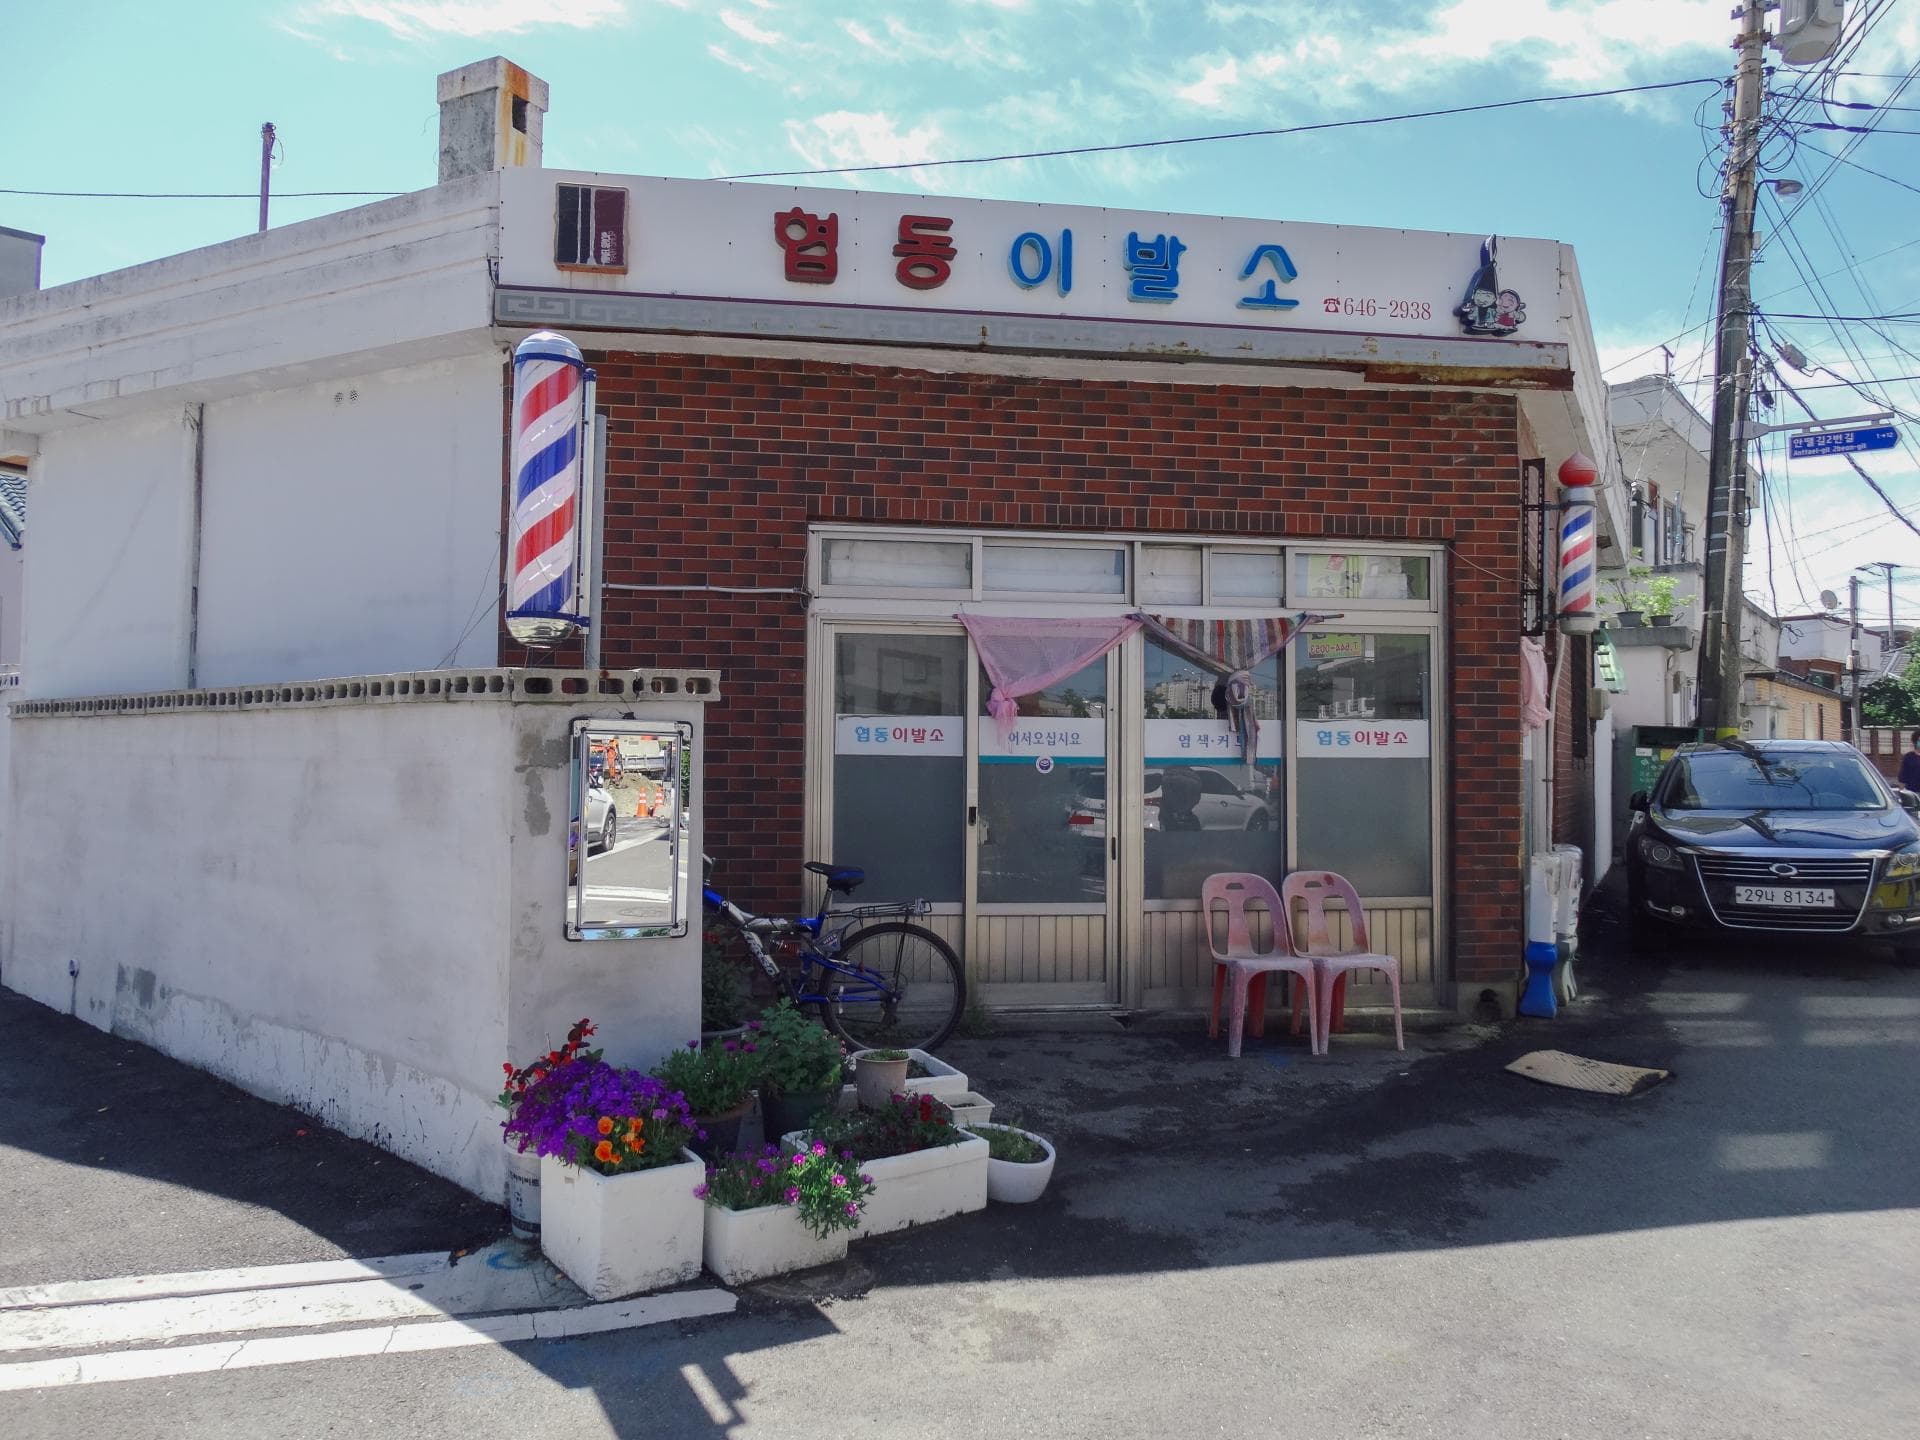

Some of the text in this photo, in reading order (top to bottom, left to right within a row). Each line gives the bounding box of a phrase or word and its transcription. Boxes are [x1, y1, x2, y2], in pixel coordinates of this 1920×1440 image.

[1344, 297, 1431, 320] 646-2938
[1008, 731, 1083, 747] 어서오십시요
[1744, 888, 1826, 905] 29나 8134
